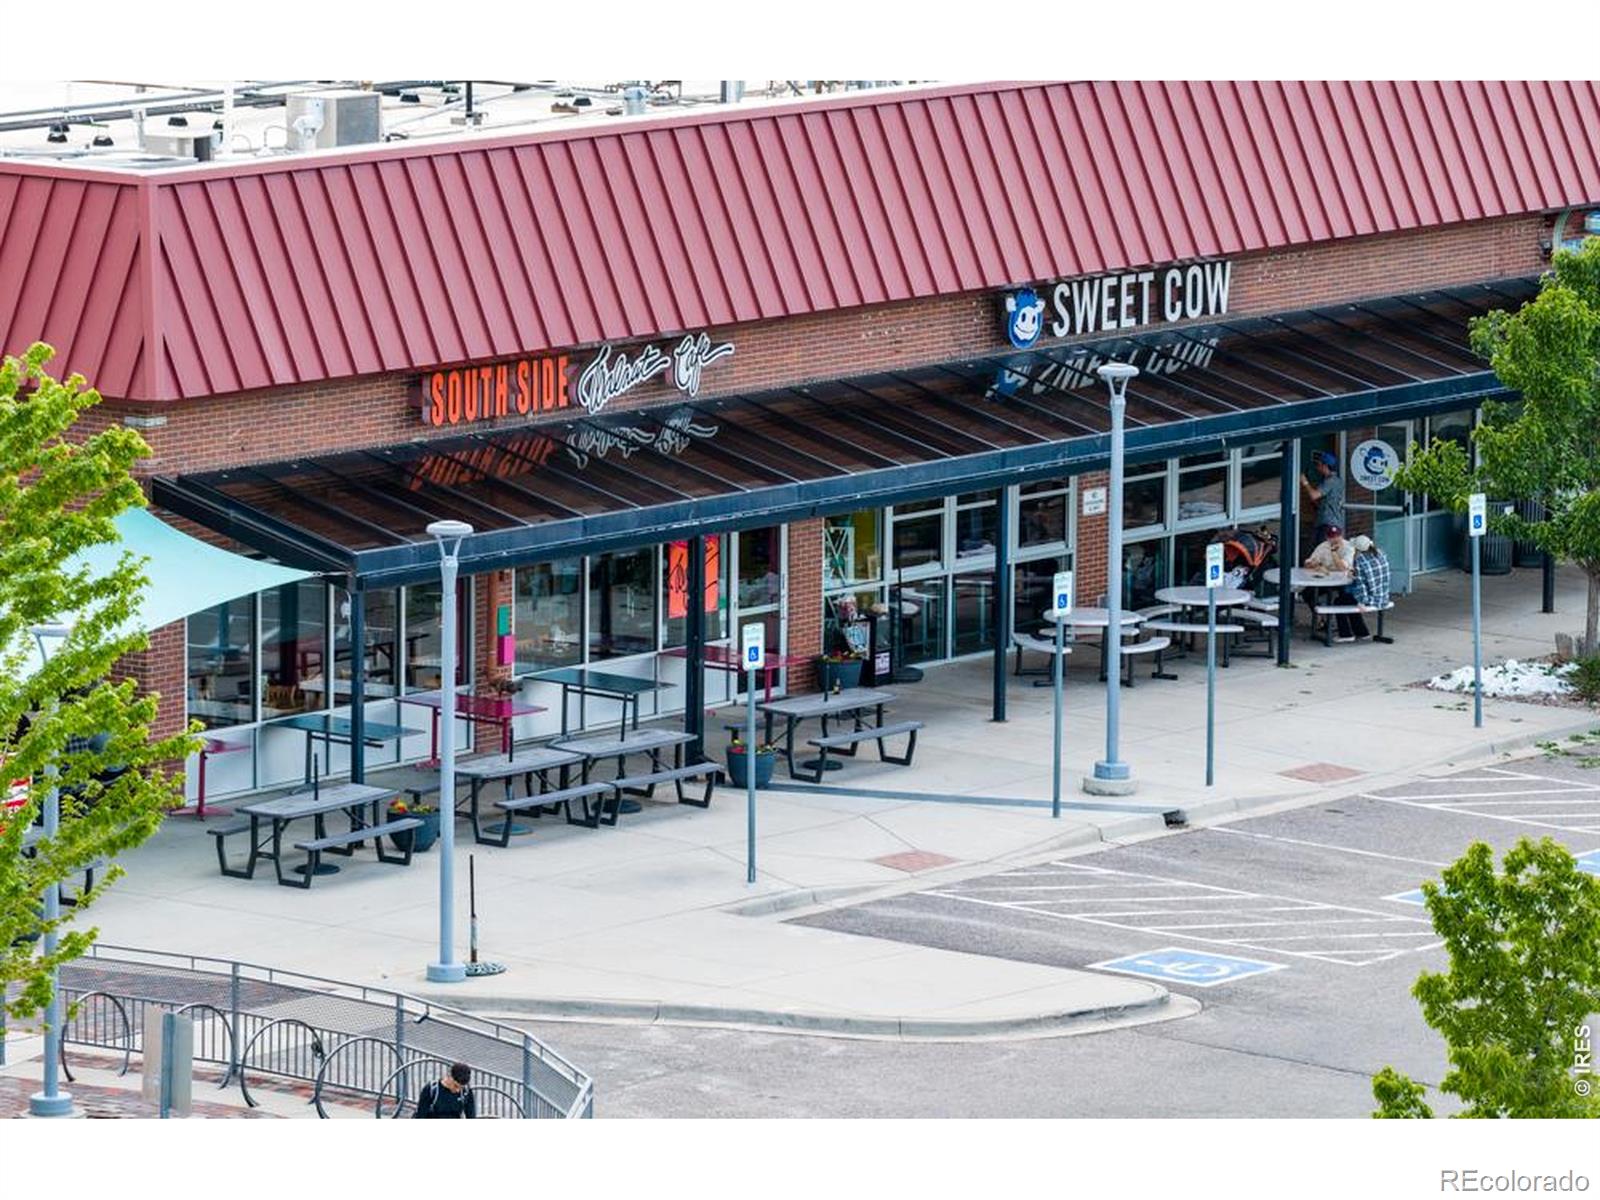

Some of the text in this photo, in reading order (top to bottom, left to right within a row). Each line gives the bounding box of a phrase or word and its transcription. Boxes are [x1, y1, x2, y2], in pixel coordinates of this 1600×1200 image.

[1052, 261, 1231, 337] SWEET COW
[430, 366, 508, 426] SOUTH
[516, 355, 569, 415] SIDE
[577, 344, 671, 415] Walnut
